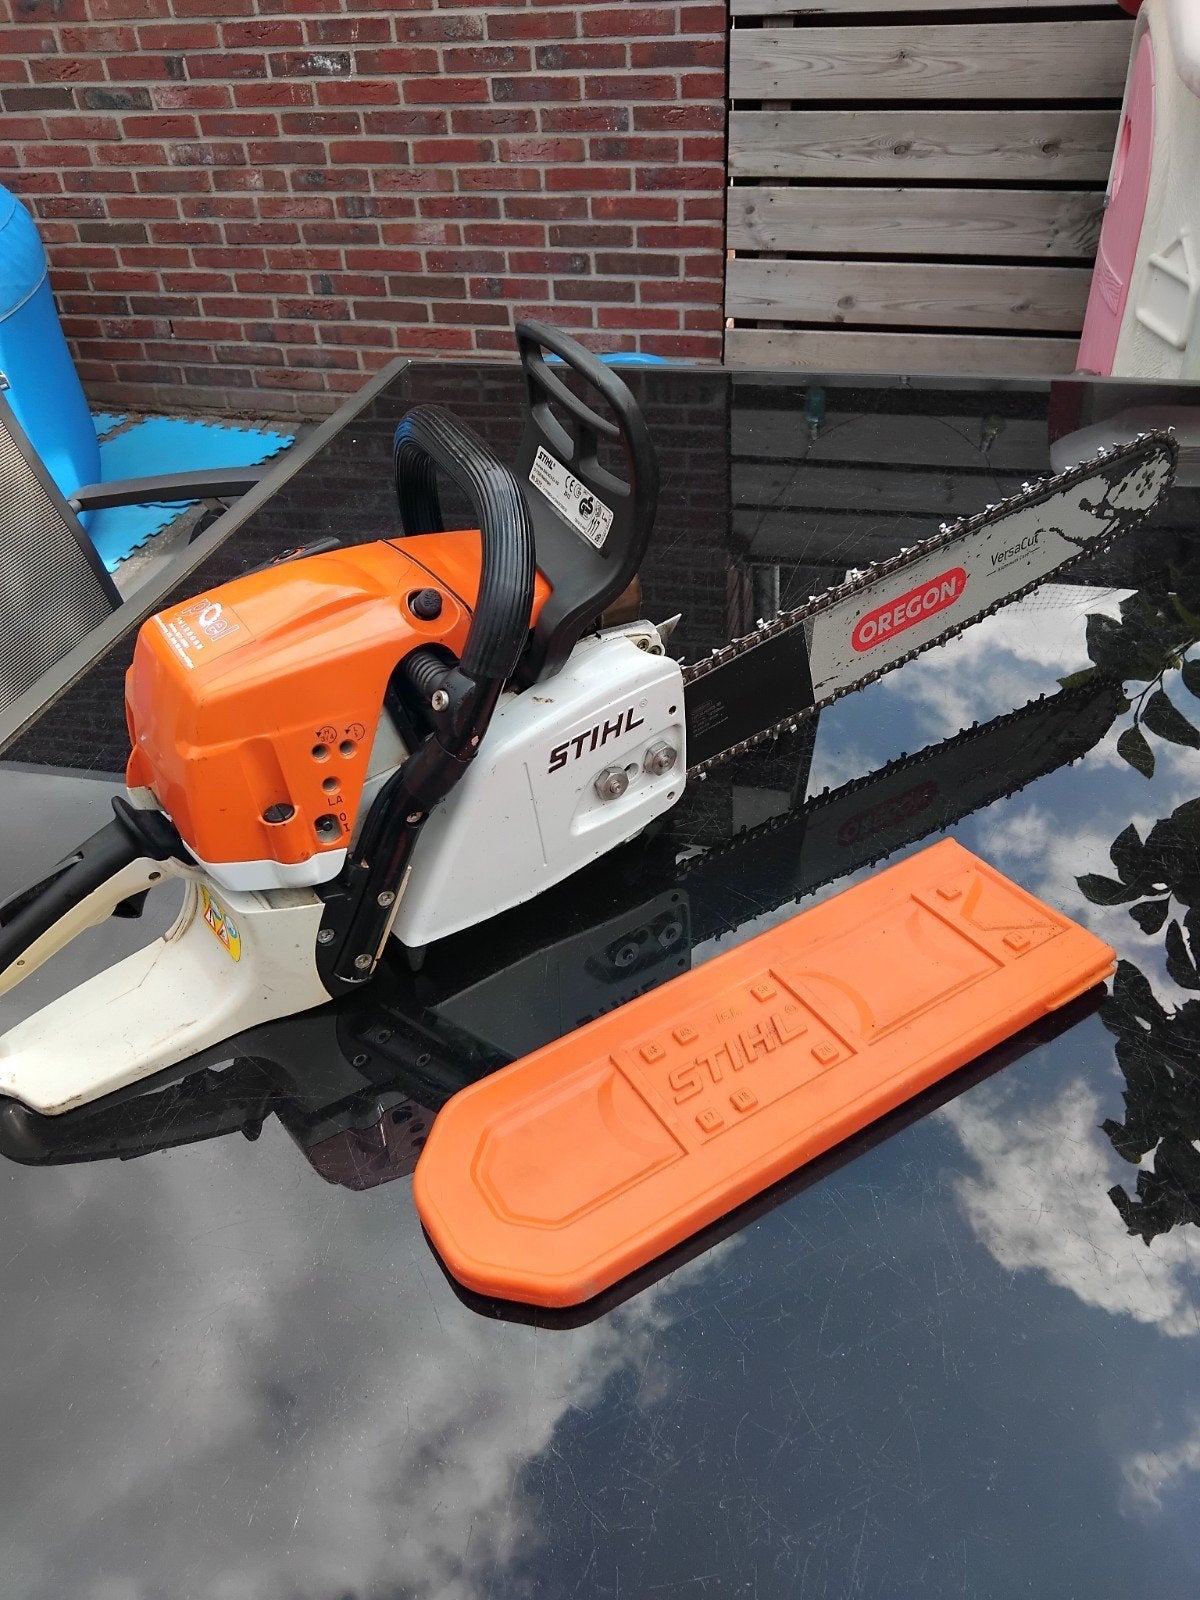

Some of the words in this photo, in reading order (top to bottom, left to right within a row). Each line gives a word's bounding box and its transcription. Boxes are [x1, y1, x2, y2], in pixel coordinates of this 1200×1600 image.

[538, 451, 553, 470] STIHL
[991, 532, 1039, 566] VersaCut
[858, 576, 957, 643] OREGON
[547, 707, 645, 774] STIHL
[327, 795, 344, 806] LA
[668, 1012, 808, 1105] STIHL
